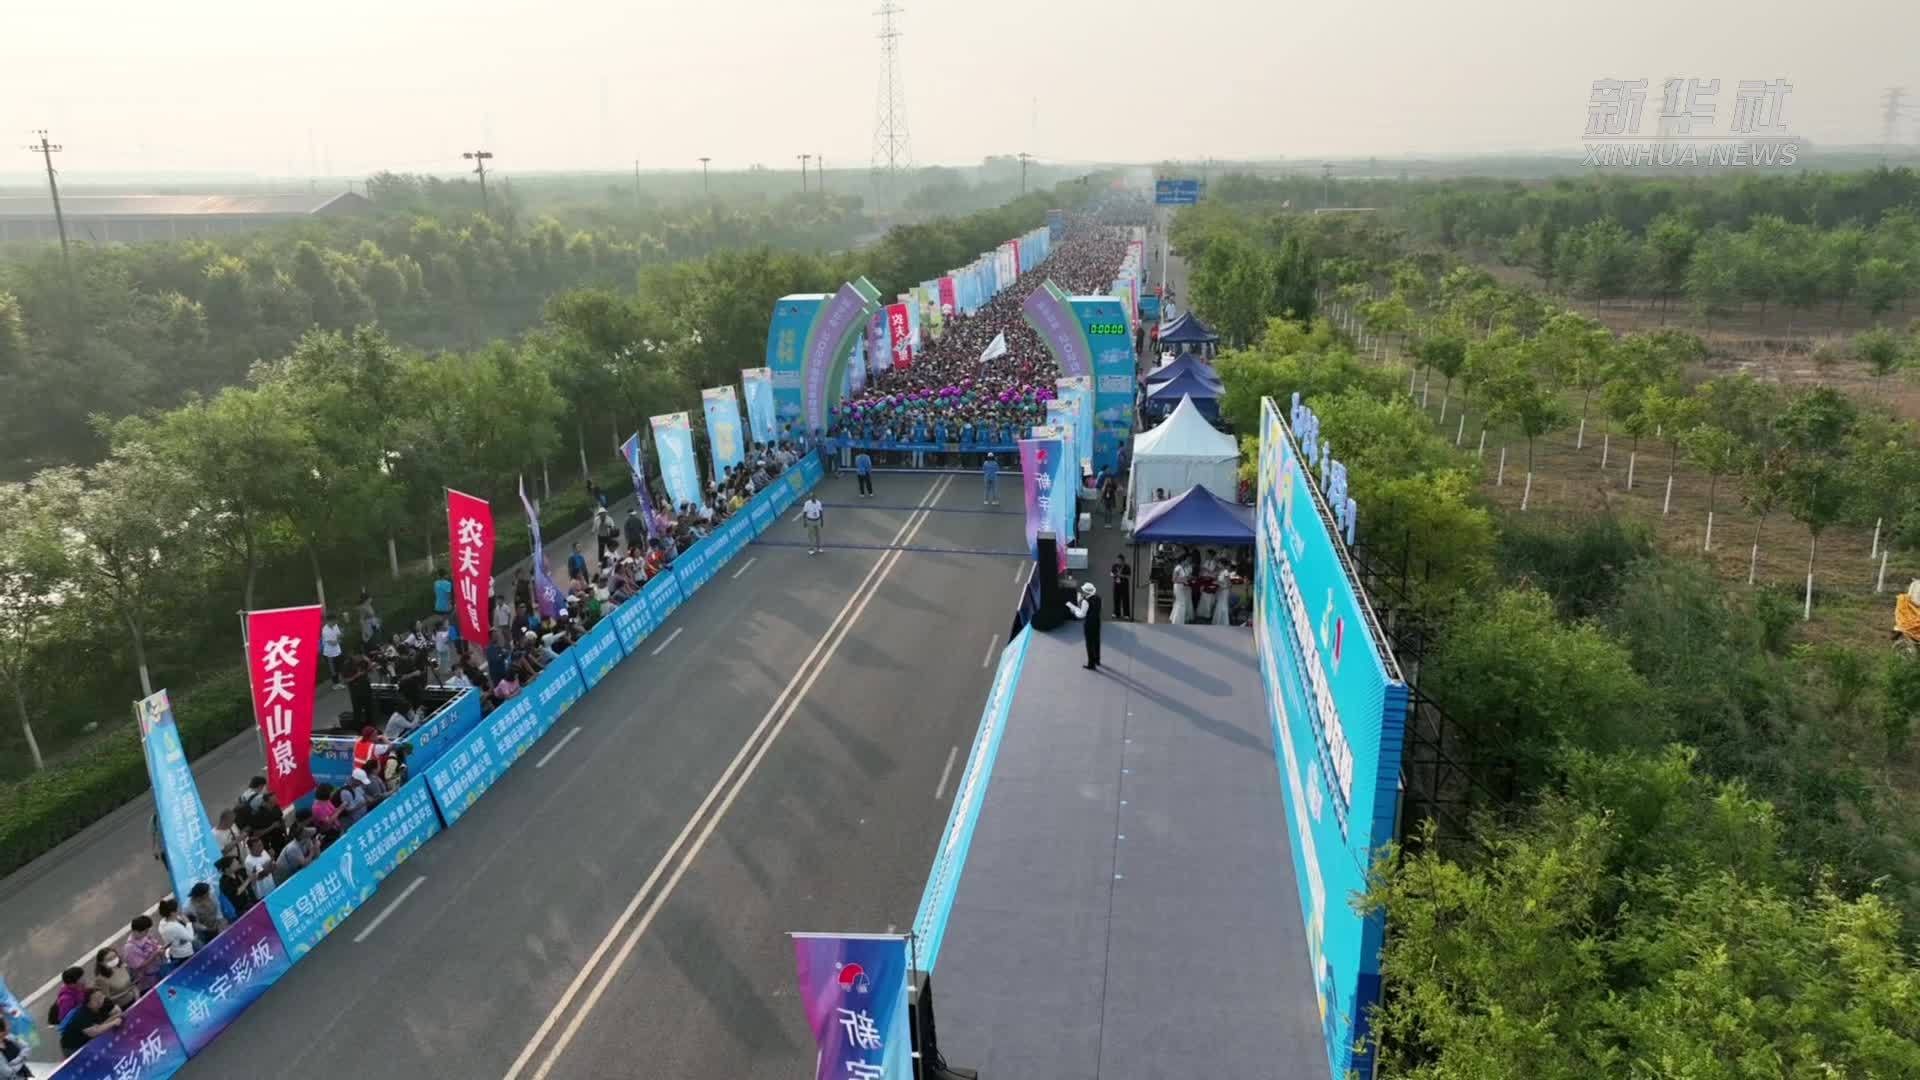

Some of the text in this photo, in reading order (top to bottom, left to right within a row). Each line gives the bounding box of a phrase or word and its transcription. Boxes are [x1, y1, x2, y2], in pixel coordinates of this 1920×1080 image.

[262, 635, 302, 776] 农夫山泉
[187, 936, 274, 1022] 新宇彩板
[96, 1028, 167, 1080] 彩板
